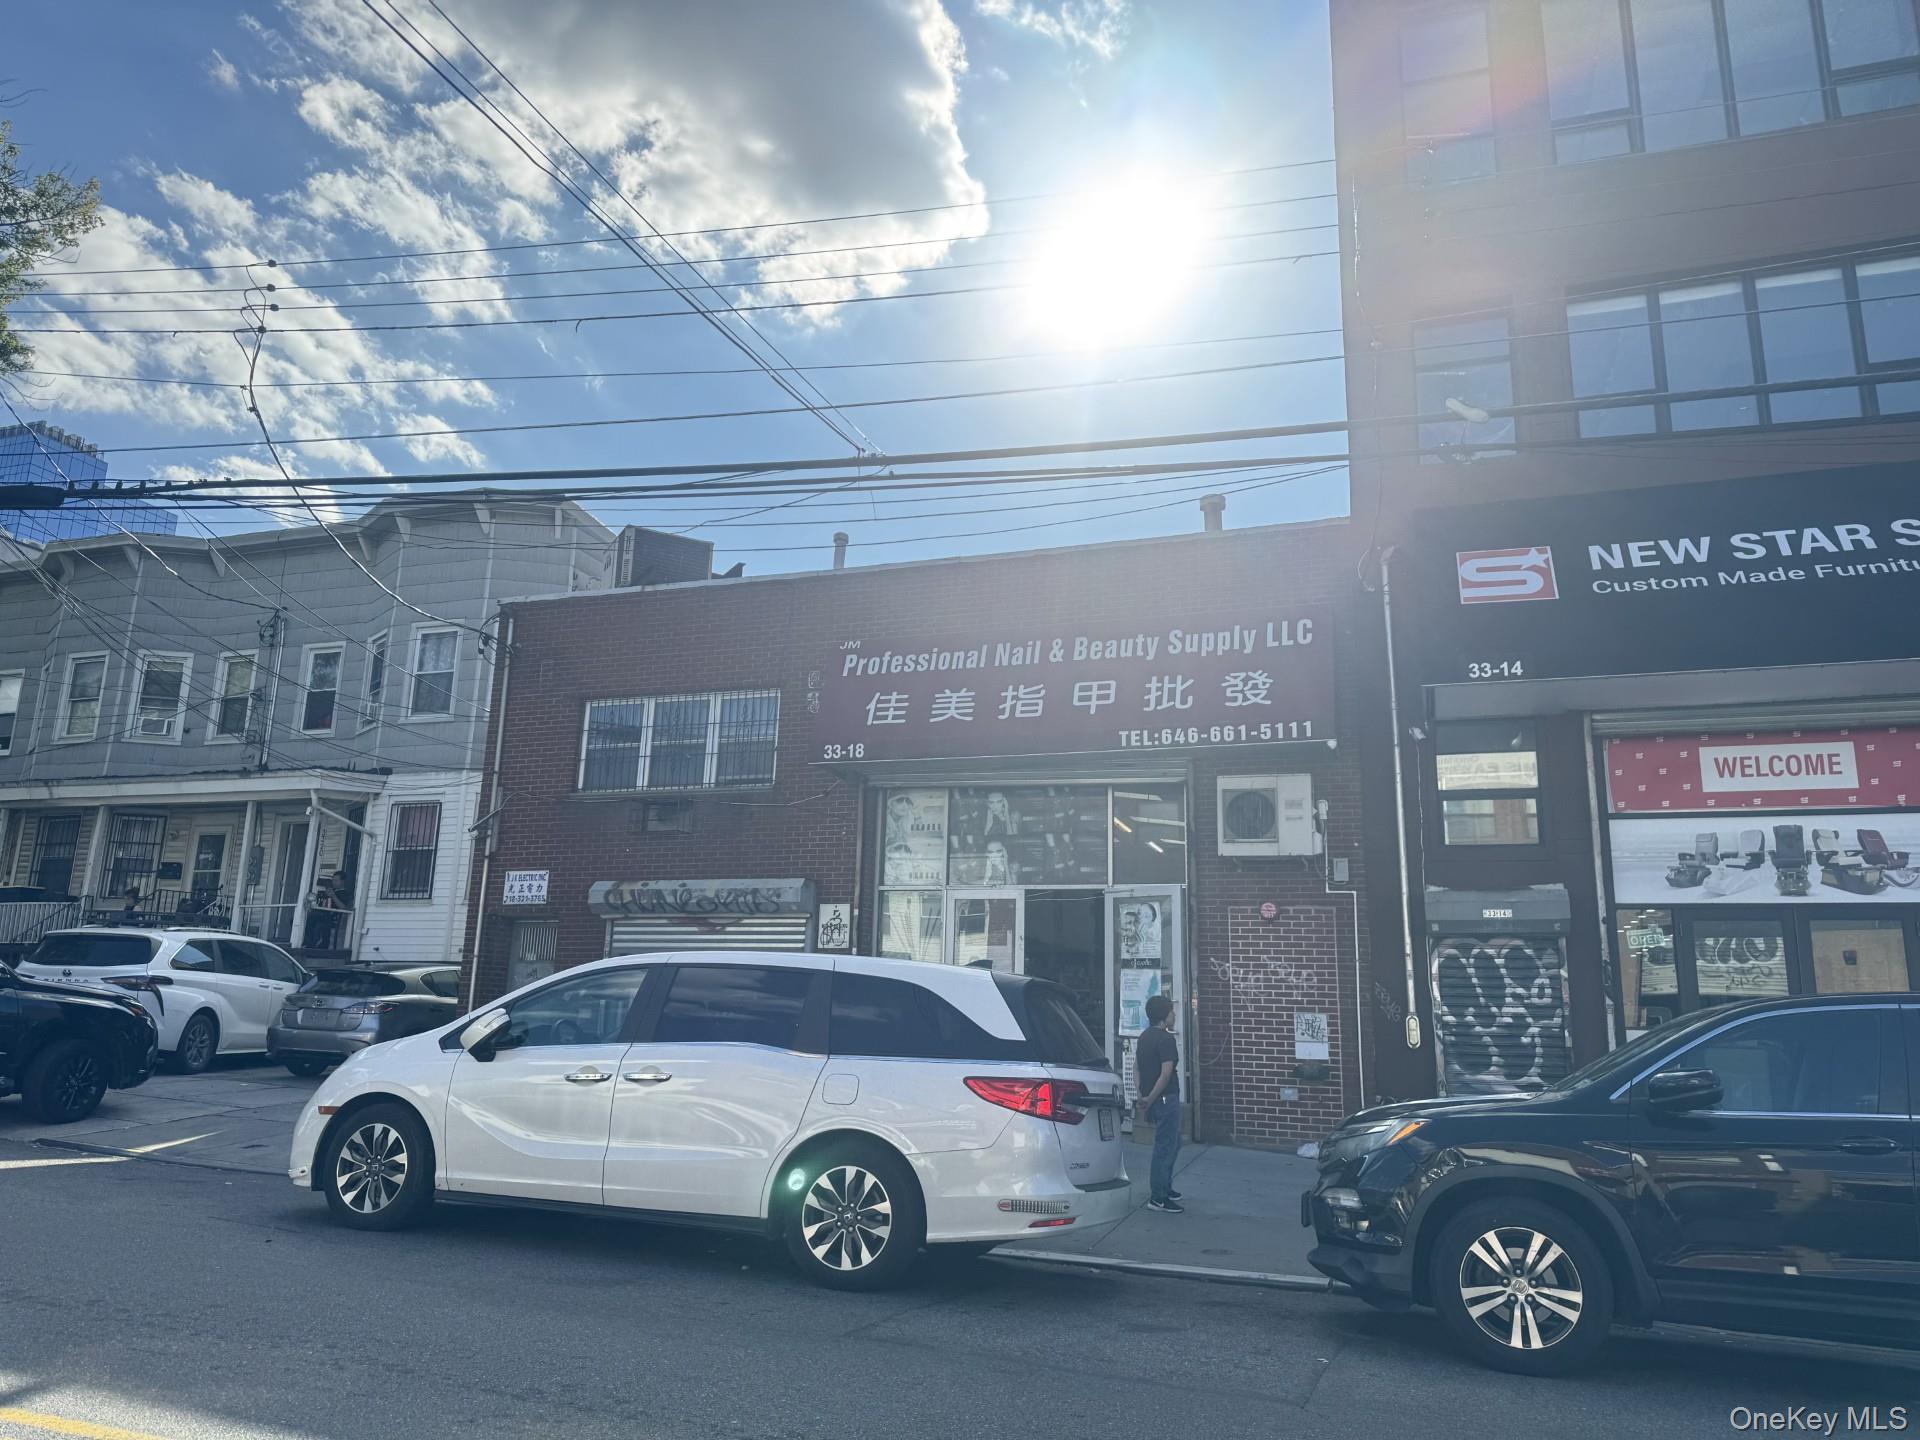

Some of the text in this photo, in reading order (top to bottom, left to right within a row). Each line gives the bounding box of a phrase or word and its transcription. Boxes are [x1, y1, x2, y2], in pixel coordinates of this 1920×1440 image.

[1588, 536, 1710, 570] NEW
[1730, 523, 1878, 559] STAR
[1592, 576, 1709, 594] Custom
[1718, 566, 1806, 585] Made
[840, 640, 861, 650] JM
[842, 618, 1313, 677] Professional Nail & Beauty Supply LLC
[1468, 660, 1523, 678] 33-14
[865, 671, 1274, 726] 佳美指甲批發
[1118, 720, 1312, 747] TEL:646-661-5111
[823, 742, 865, 760] 33-18
[1713, 753, 1843, 778] WELCOME
